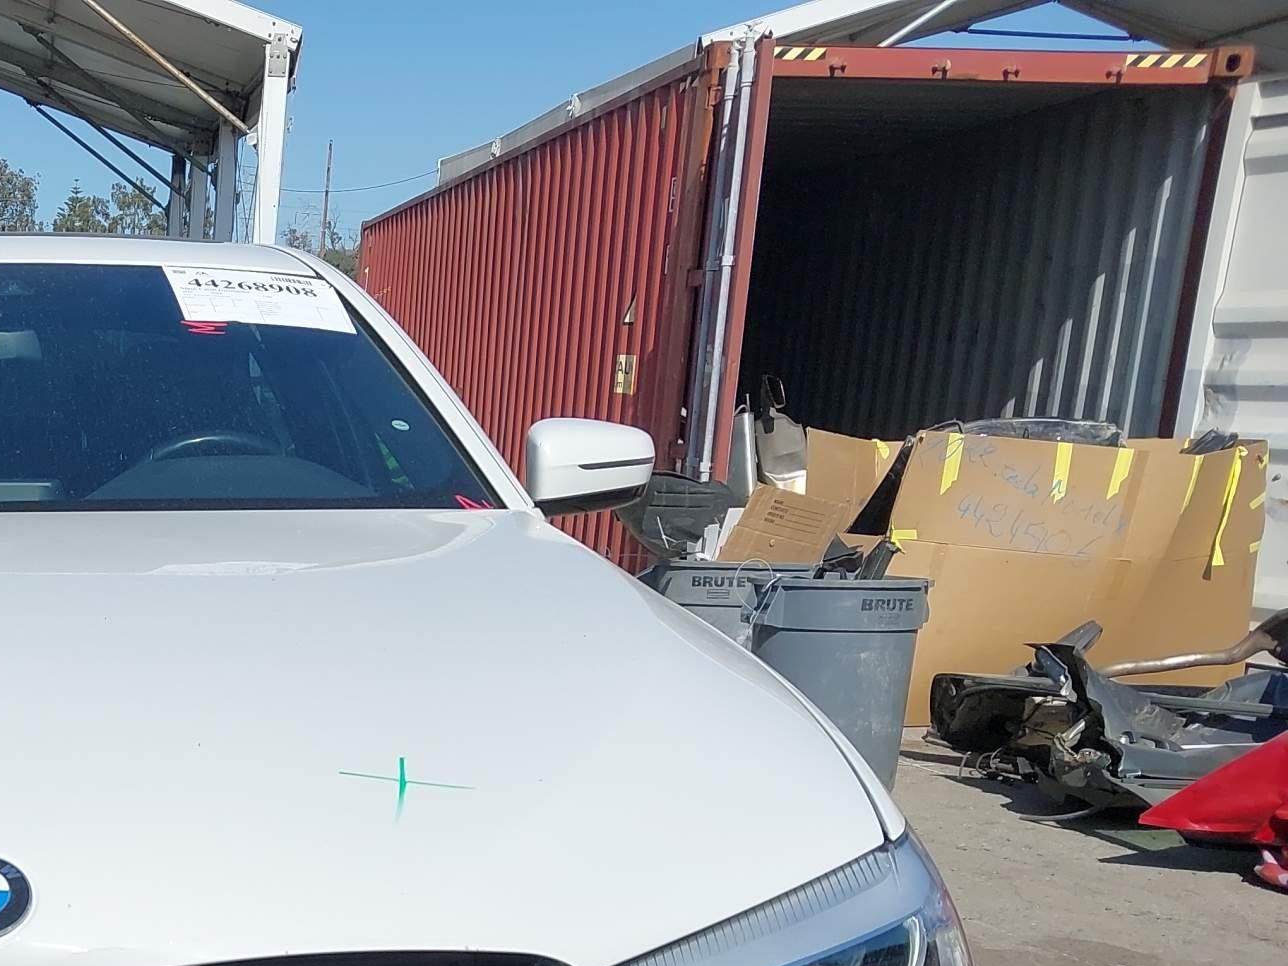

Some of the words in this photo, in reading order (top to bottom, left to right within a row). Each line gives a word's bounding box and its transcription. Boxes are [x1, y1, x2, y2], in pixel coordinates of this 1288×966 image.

[187, 277, 318, 298] 44268908
[691, 575, 747, 588] BRUTE
[861, 598, 914, 612] BRUTE
